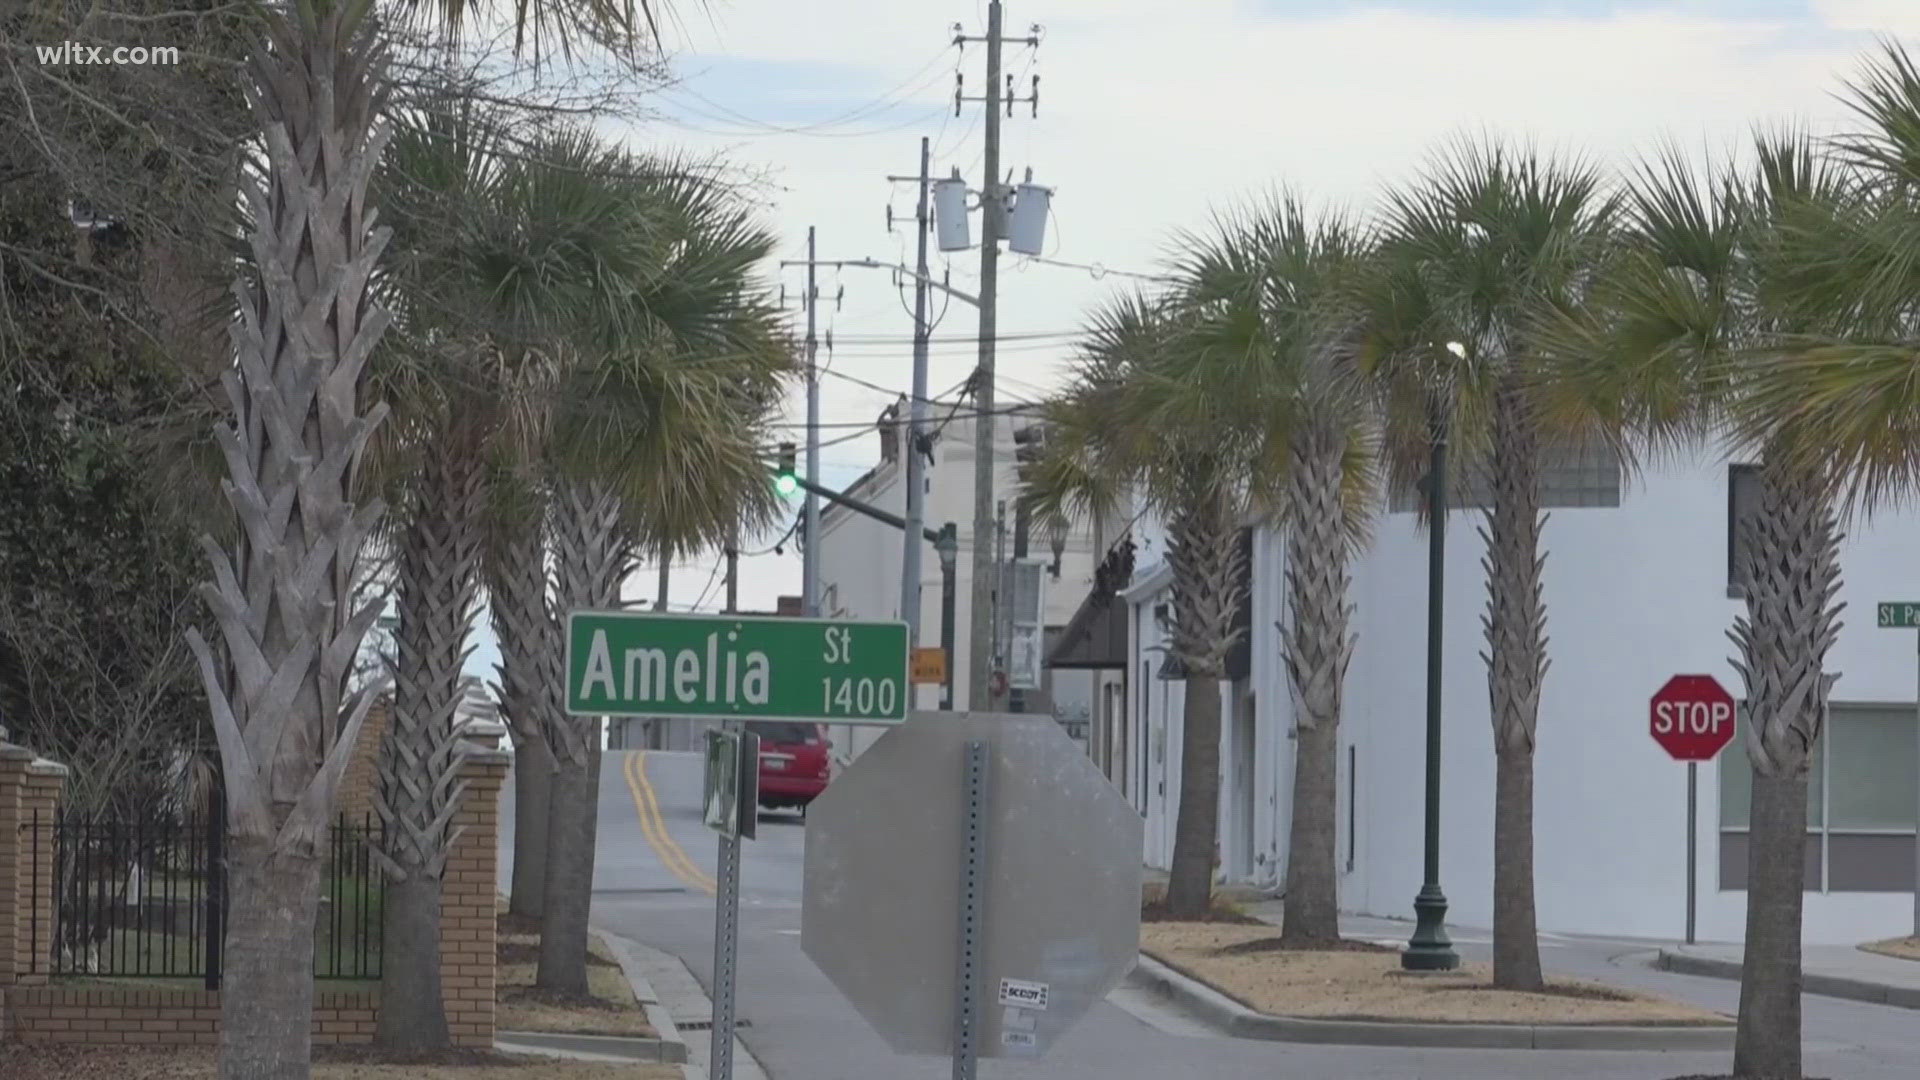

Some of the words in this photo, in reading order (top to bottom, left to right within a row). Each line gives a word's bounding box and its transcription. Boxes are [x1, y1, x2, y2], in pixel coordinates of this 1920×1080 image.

[1880, 605, 1895, 625] St
[579, 628, 771, 705] Amelia
[823, 626, 852, 665] St
[822, 677, 897, 716] 1400
[1654, 701, 1731, 734] STOP
